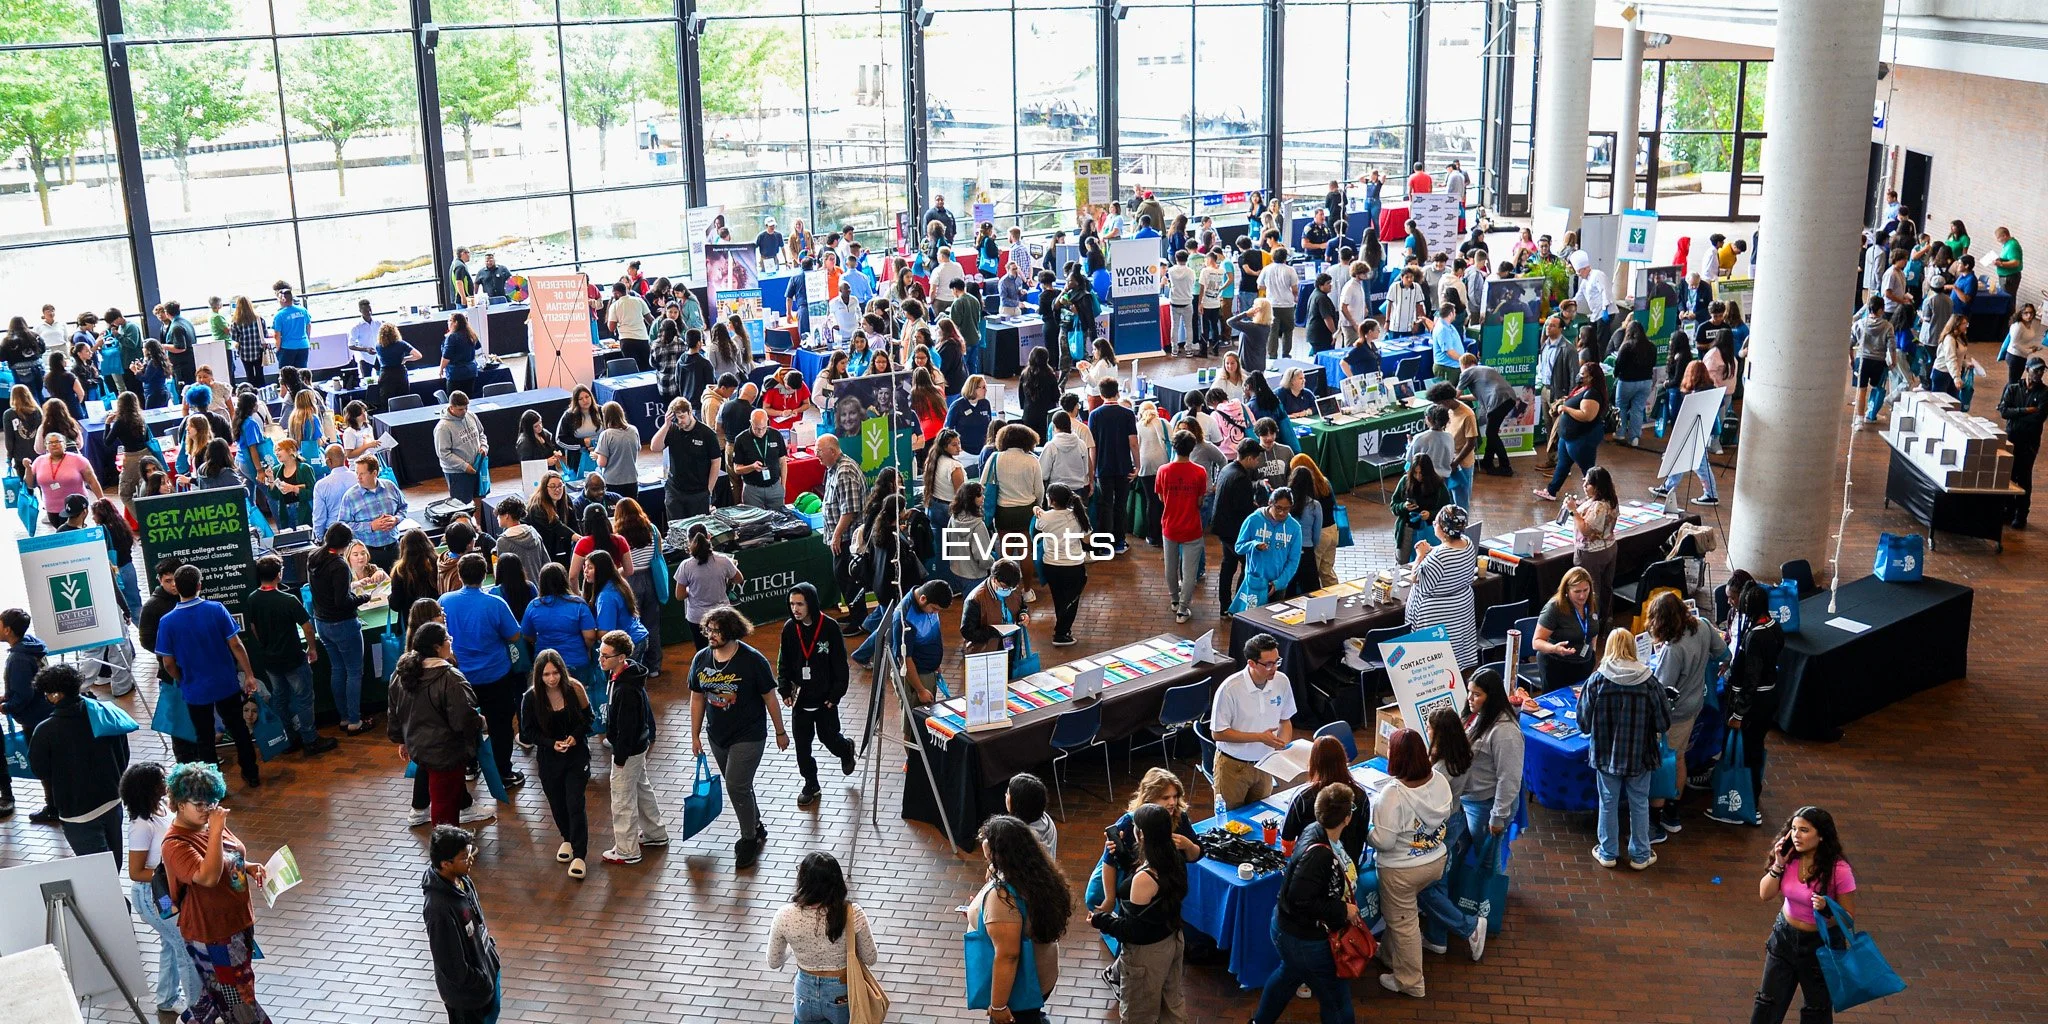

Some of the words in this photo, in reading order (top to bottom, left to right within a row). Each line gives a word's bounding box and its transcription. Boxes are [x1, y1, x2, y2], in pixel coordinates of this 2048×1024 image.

[1116, 265, 1150, 277] WORK
[1118, 275, 1154, 287] LEARN
[1504, 364, 1531, 373] COLLEGE.
[1258, 465, 1280, 474] NORTH
[146, 510, 180, 528] GET
[184, 502, 240, 523] AHEAD.
[148, 525, 185, 543] STAY
[188, 519, 242, 538] AHEAD.
[173, 548, 190, 557] FREE
[192, 546, 215, 556] college
[216, 543, 238, 551] credits
[190, 553, 210, 562] school
[210, 564, 218, 572] to
[224, 563, 247, 572] degree
[751, 570, 796, 592] TECH
[200, 584, 219, 594] chool
[220, 583, 246, 591] students
[207, 591, 228, 600] million
[58, 612, 71, 620] IVY
[73, 608, 93, 618] TECH
[1400, 658, 1426, 671] CONTACT
[1426, 652, 1443, 662] CARD!
[697, 671, 742, 684] Mustang
